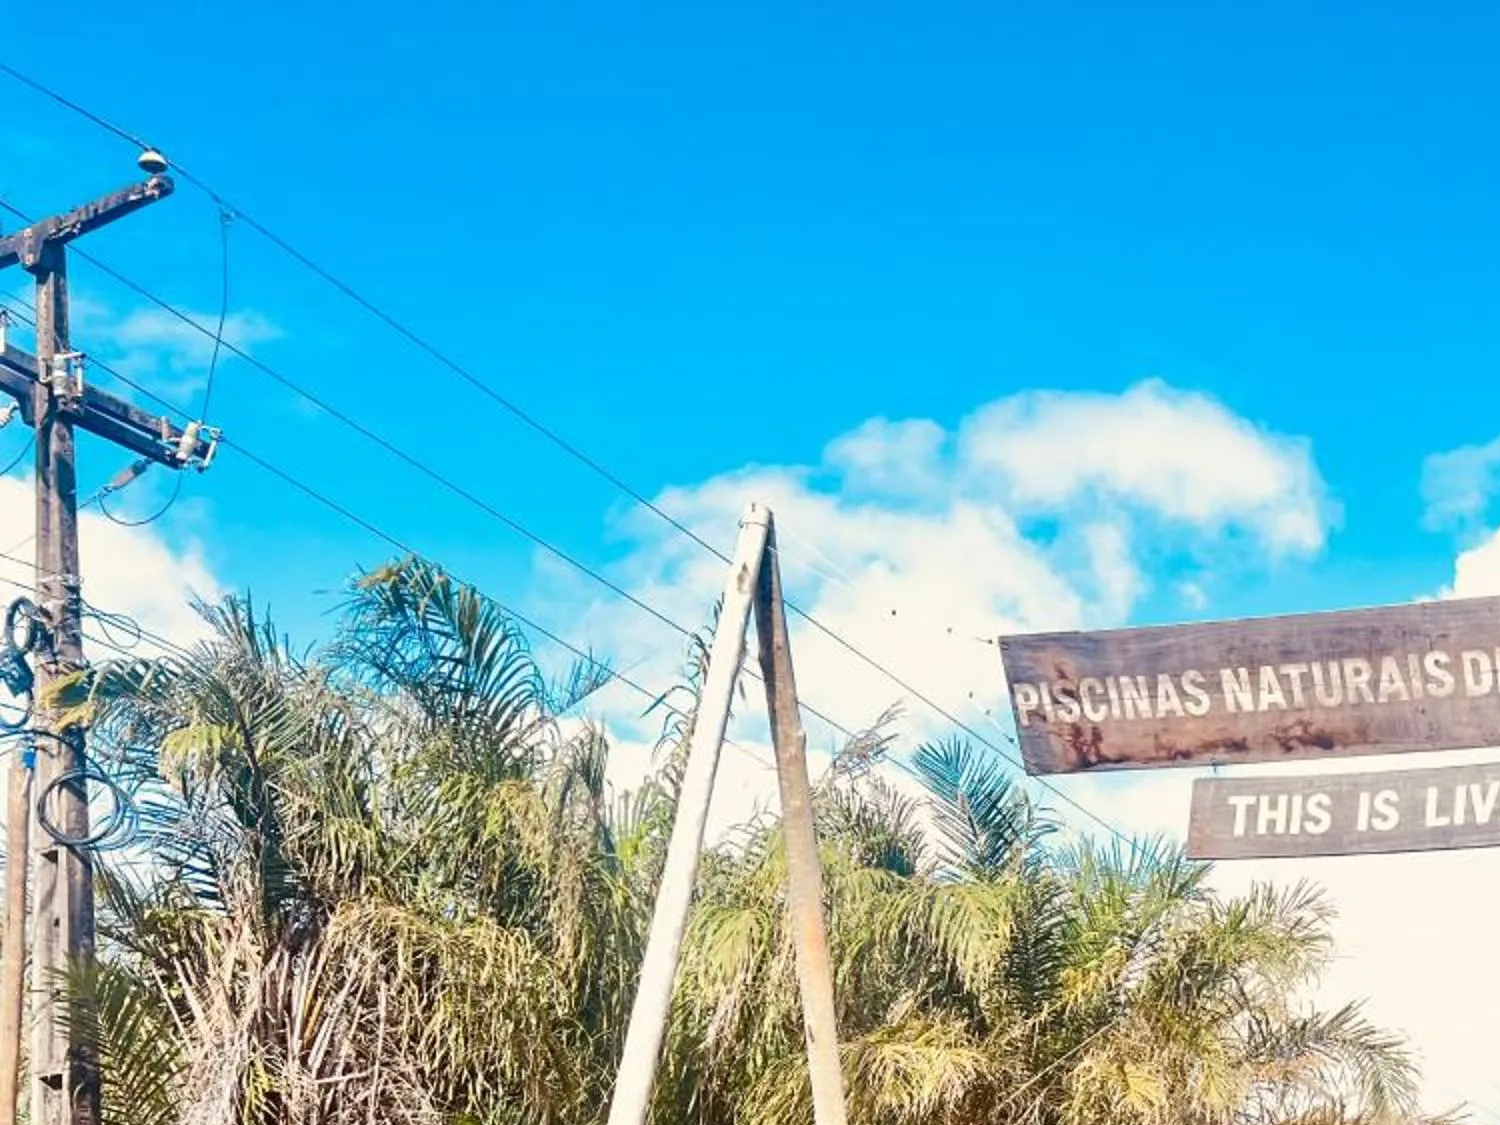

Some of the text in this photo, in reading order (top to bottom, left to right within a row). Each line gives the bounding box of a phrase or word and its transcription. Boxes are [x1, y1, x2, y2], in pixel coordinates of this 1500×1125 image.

[1014, 670, 1210, 726] PISCINAS
[1219, 650, 1455, 713] NATURAIS
[1228, 791, 1332, 837] THIS
[1357, 790, 1400, 831] IS
